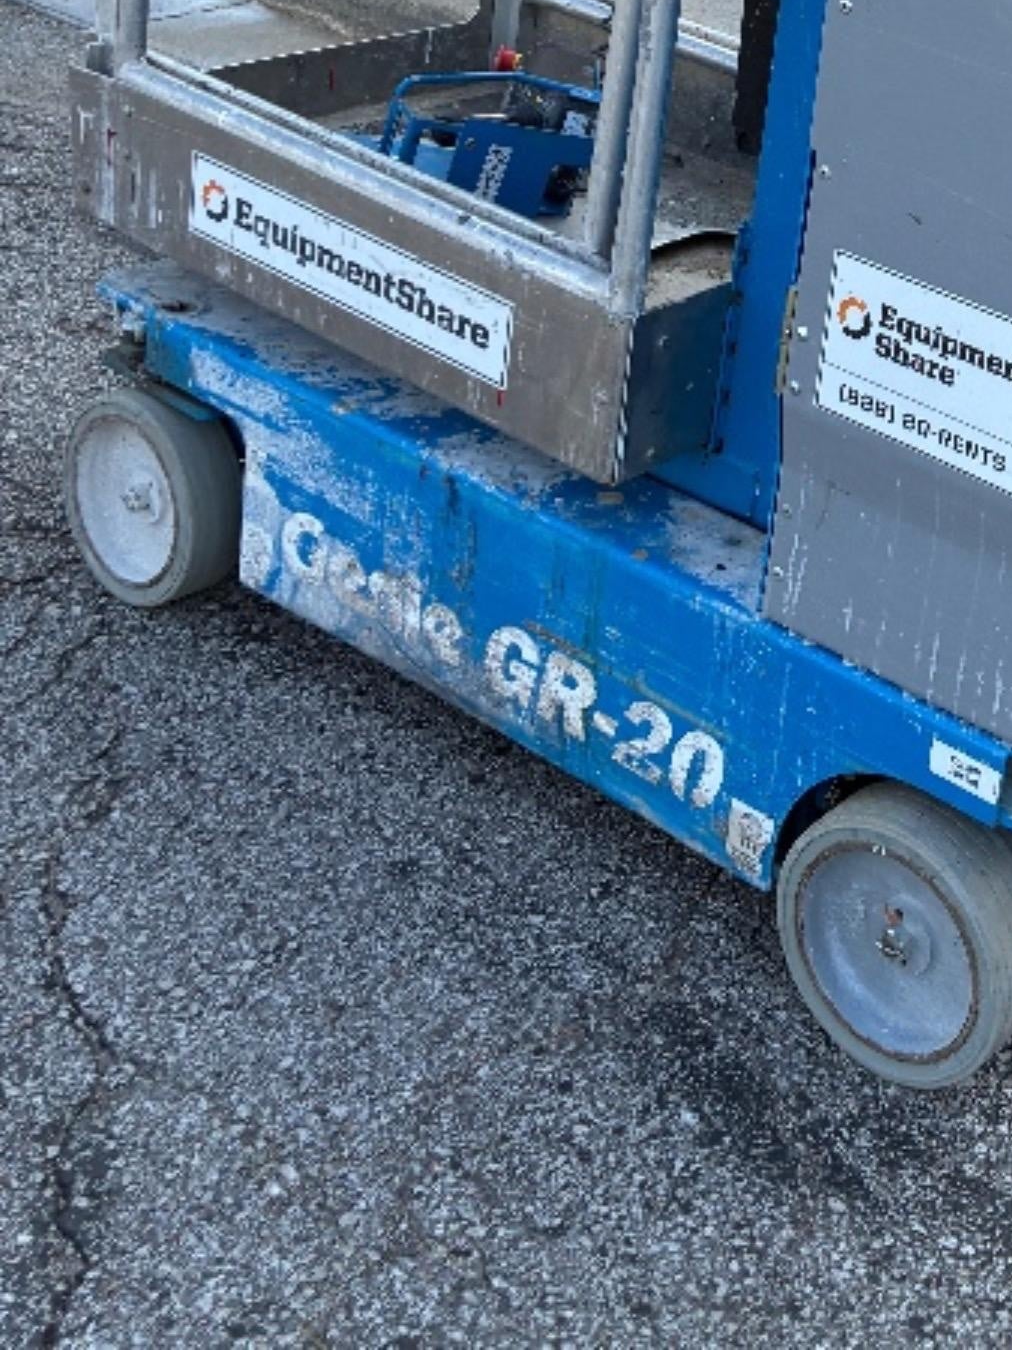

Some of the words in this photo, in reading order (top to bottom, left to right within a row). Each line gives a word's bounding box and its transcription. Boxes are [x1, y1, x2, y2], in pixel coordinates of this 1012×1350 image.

[233, 197, 491, 350] EquipmentShare
[874, 332, 956, 387] Share
[484, 625, 724, 809] GR-20
